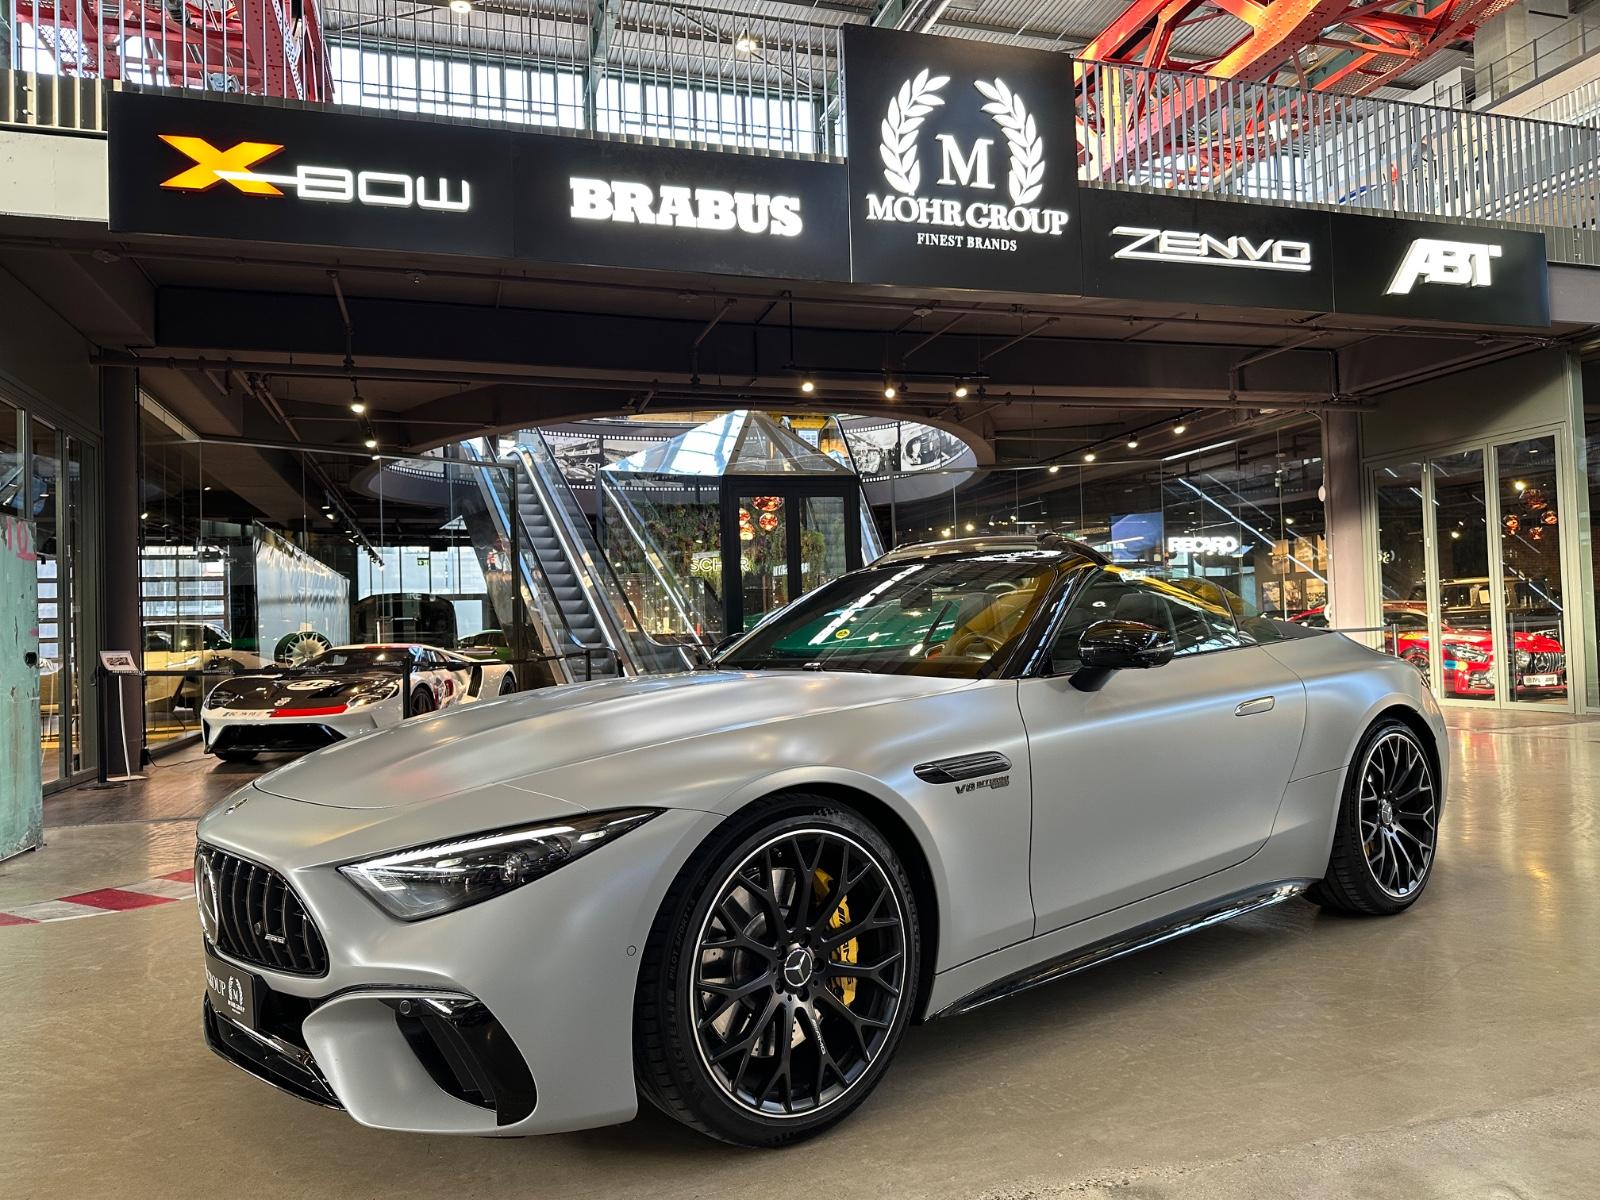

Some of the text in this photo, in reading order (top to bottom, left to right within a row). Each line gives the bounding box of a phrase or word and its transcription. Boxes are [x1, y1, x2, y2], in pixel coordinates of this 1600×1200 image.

[935, 133, 996, 190] M
[569, 176, 803, 237] BRABUS
[865, 193, 1069, 236] MOHR GROUP
[916, 232, 1018, 252] FINEST BRANDS
[1109, 225, 1313, 273] ZENVO
[1384, 237, 1503, 296] ABT
